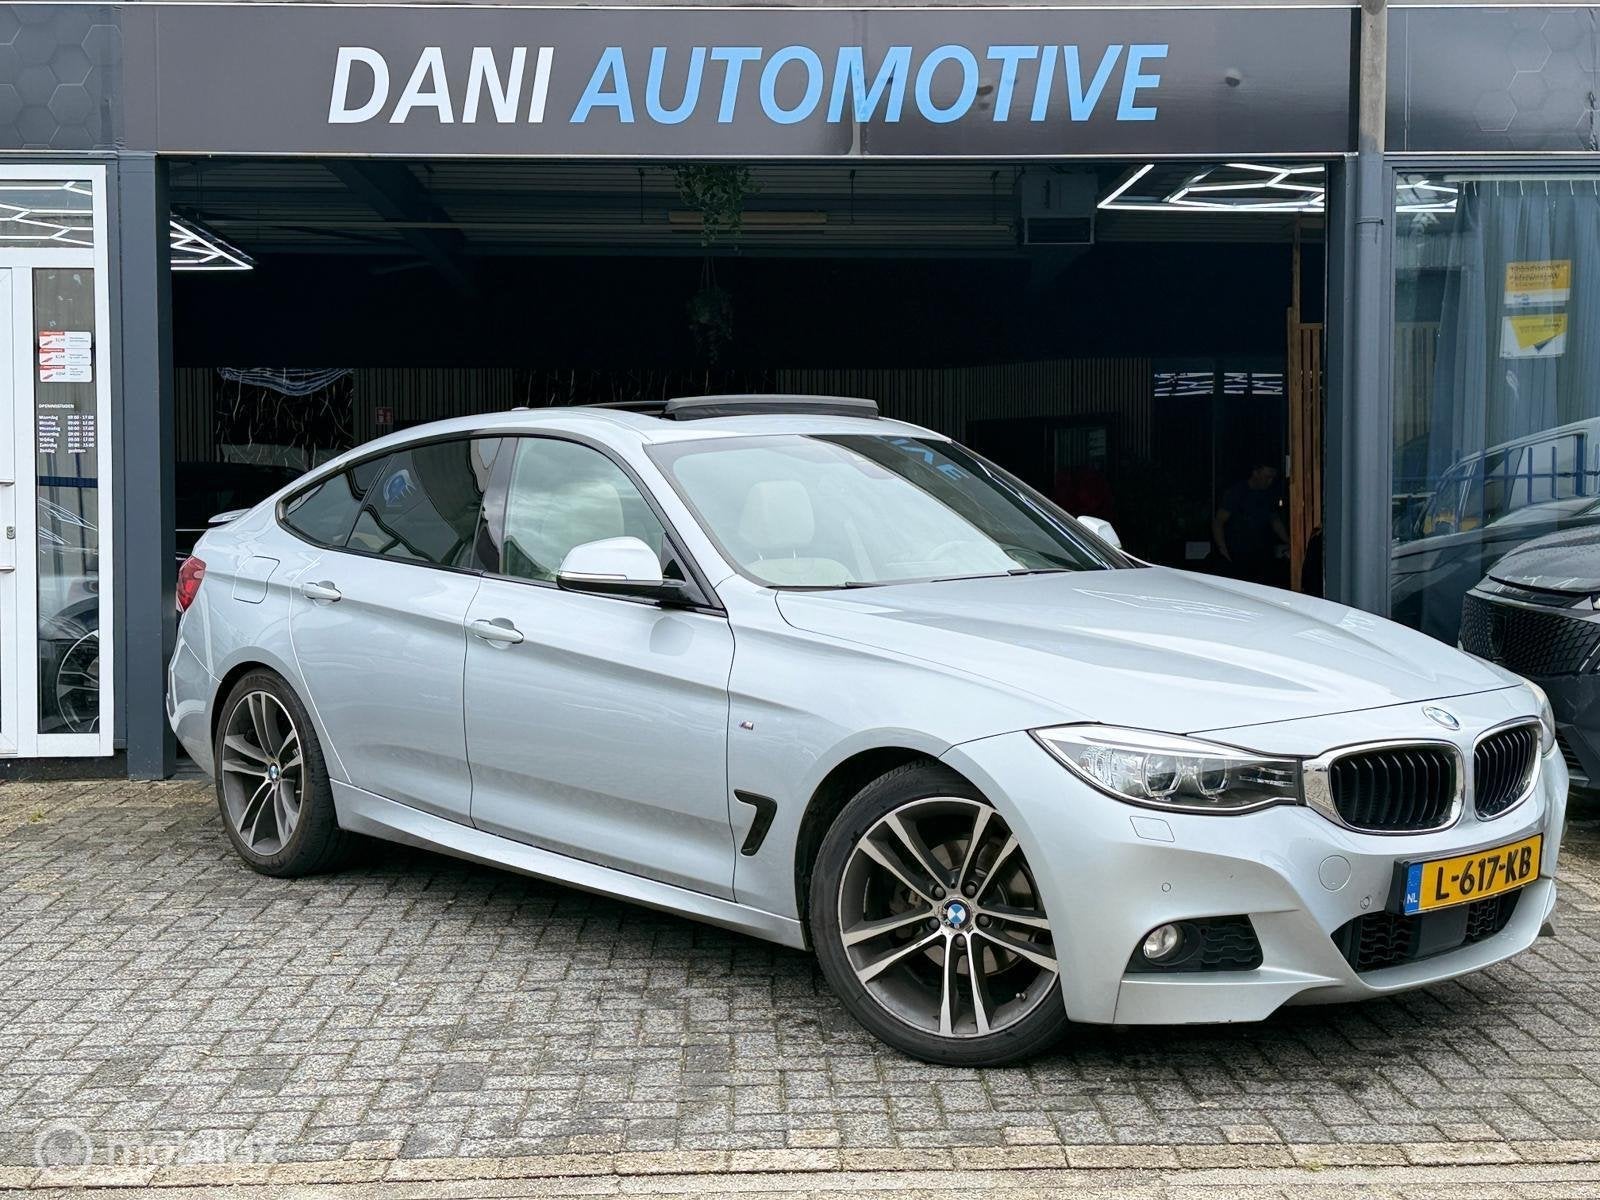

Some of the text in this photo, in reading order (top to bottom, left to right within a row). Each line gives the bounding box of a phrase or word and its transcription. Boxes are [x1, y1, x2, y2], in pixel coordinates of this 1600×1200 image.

[328, 44, 1169, 124] DANI AUTOMOTIVE
[1406, 893, 1418, 904] NL
[1435, 846, 1532, 901] L-617-KB
